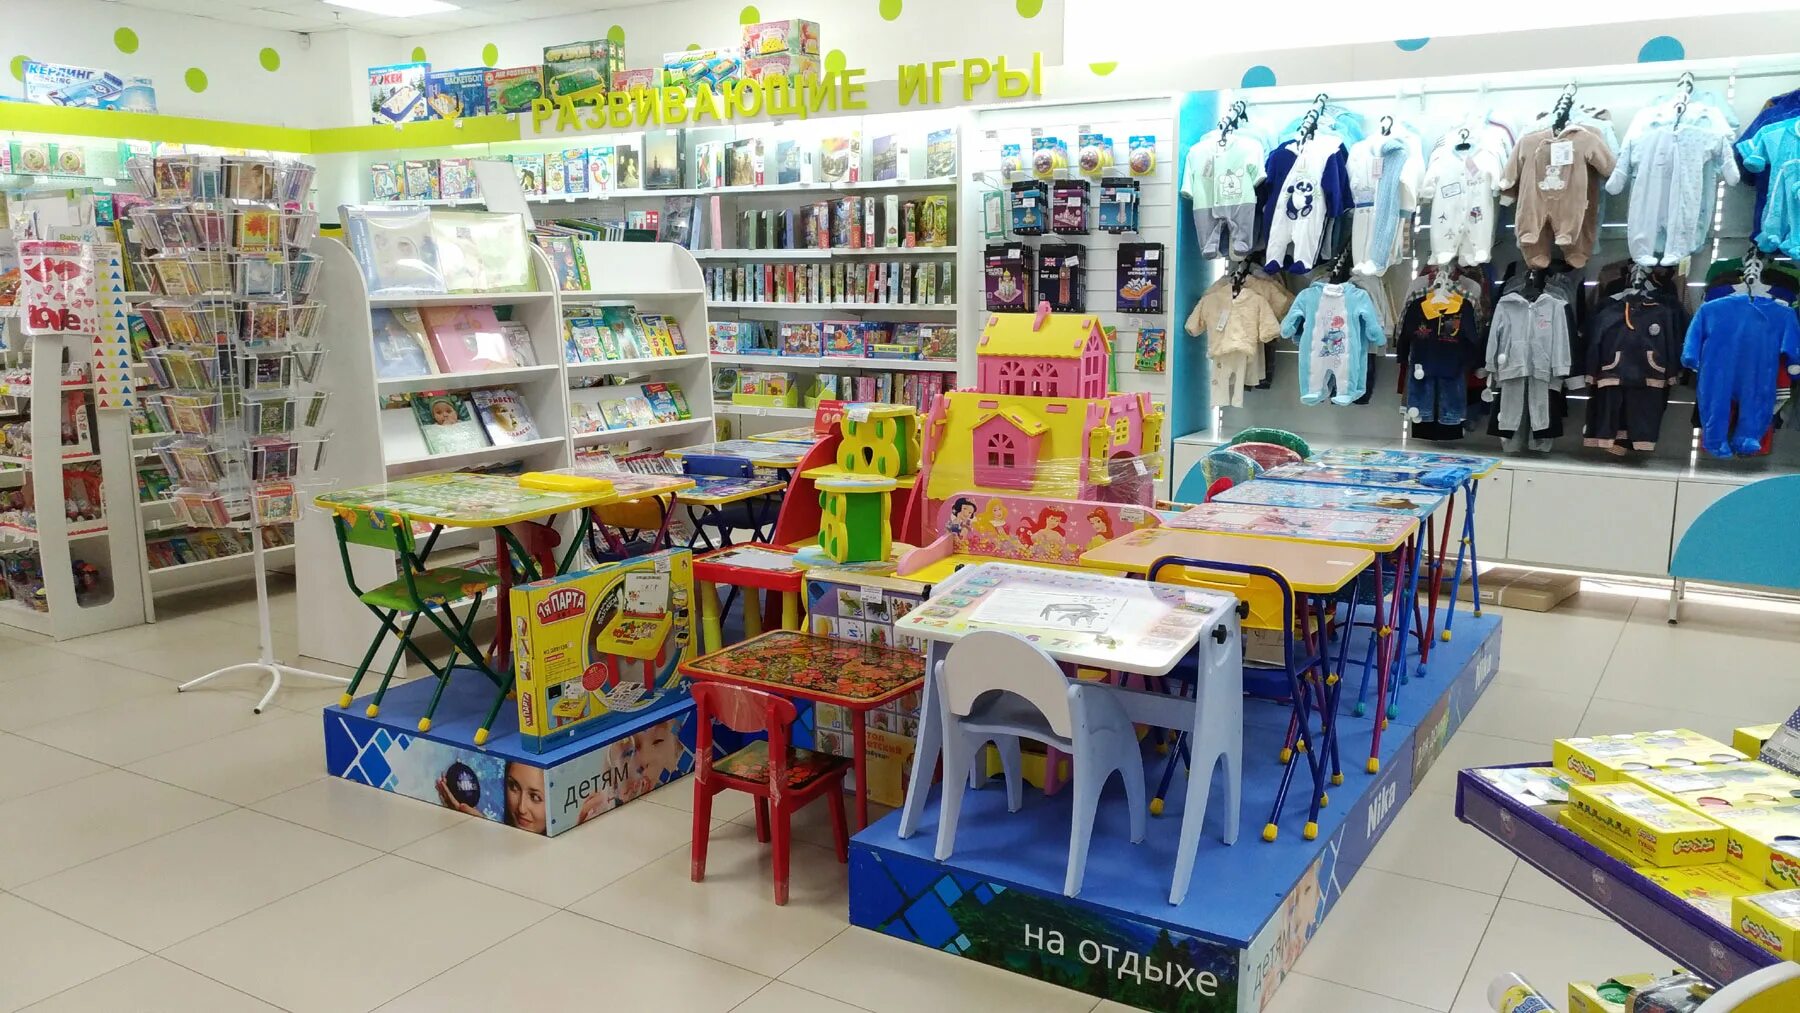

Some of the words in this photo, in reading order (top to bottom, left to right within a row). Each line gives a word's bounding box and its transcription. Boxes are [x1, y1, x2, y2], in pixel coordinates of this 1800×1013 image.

[28, 64, 95, 80] КЕРЛИНГ
[444, 74, 482, 85] БАСКЕТБОЛ
[532, 68, 868, 134] РАЗВИВАЮЩИЕ
[898, 52, 1043, 106] ИГРЫ
[538, 605, 552, 618] 1я
[550, 591, 584, 613] ПАРТА
[563, 761, 629, 813] детям
[1366, 781, 1396, 839] Nika
[1024, 923, 1065, 956] на
[1078, 939, 1219, 997] отдыхе
[1252, 921, 1291, 1002] детям
